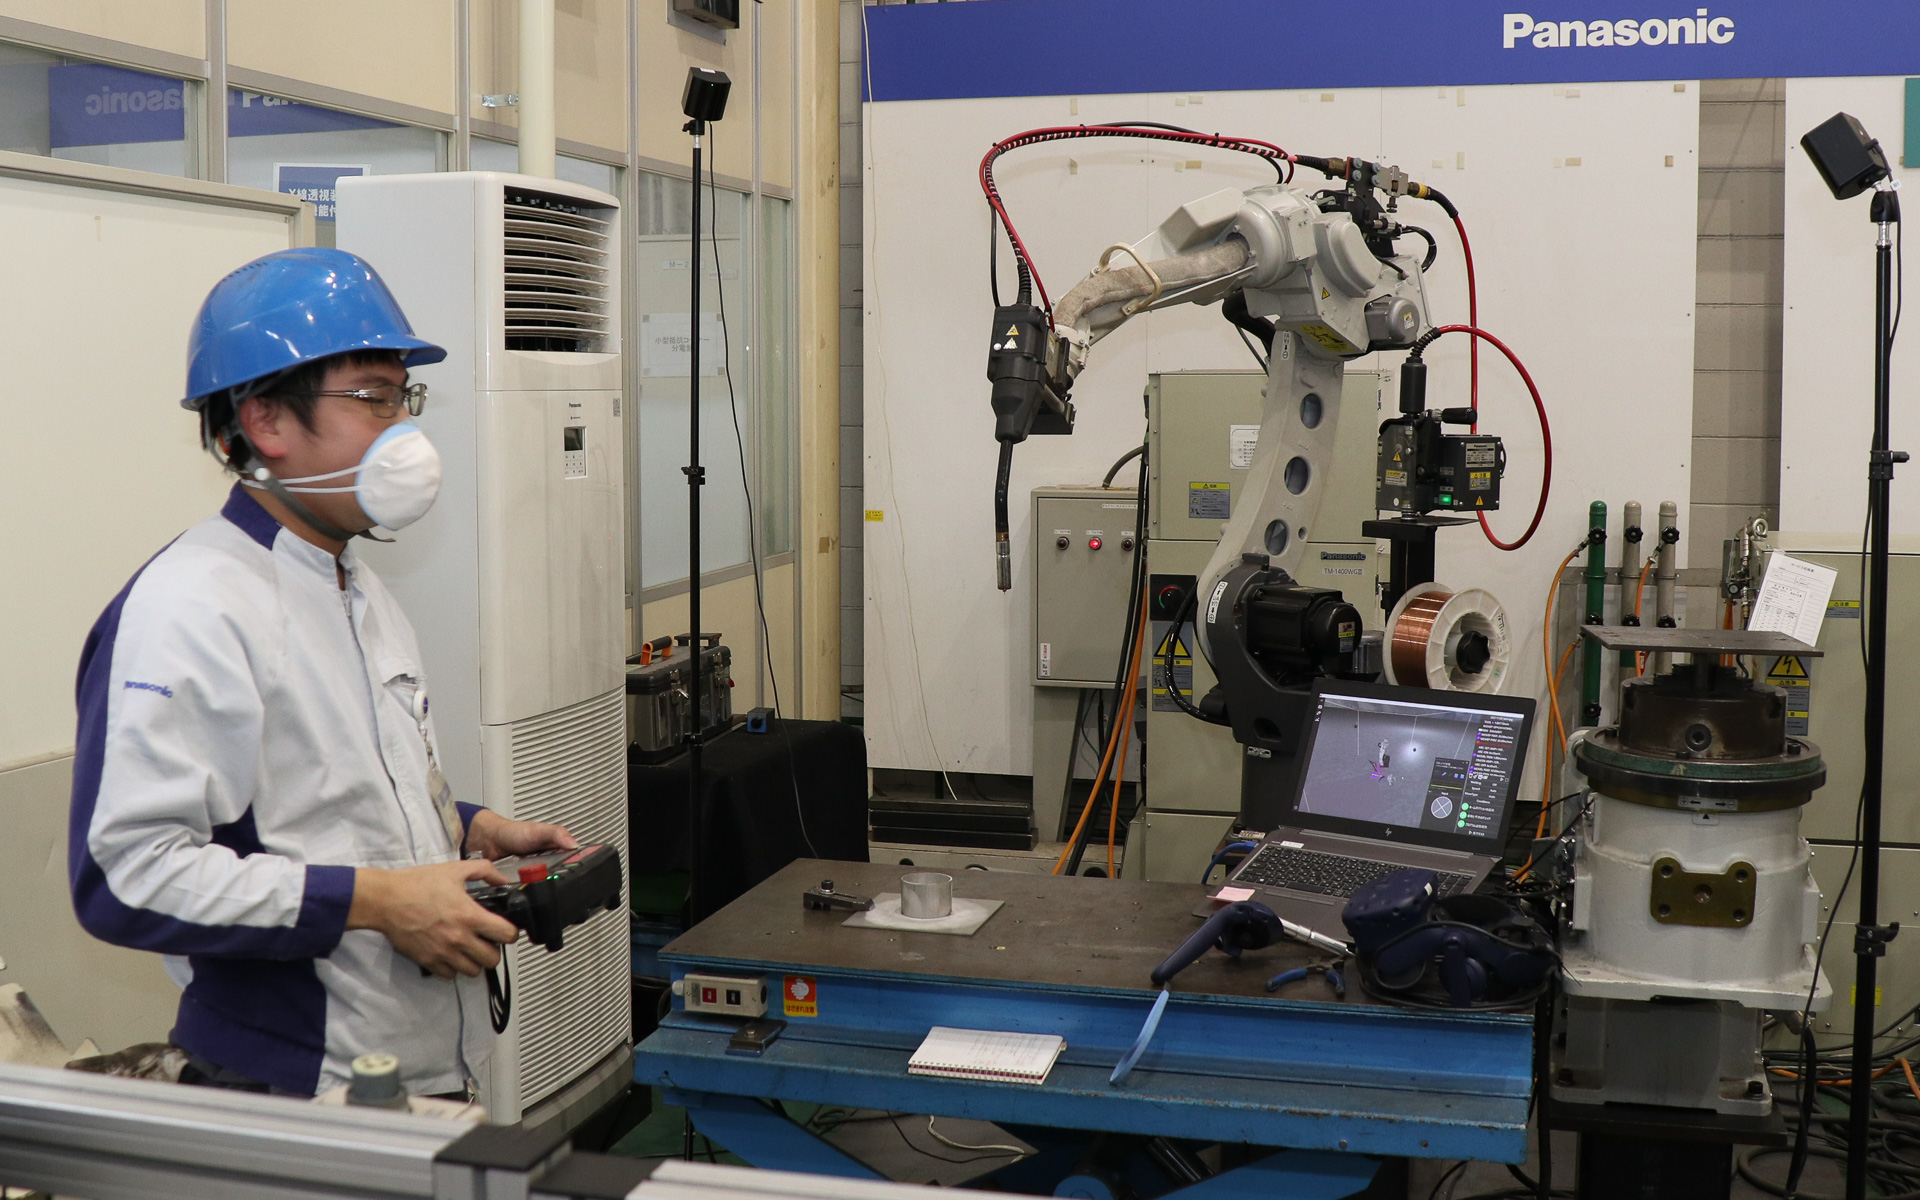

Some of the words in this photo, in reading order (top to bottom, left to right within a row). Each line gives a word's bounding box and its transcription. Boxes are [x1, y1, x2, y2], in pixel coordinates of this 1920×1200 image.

[1502, 8, 1736, 48] Panasonic
[655, 336, 710, 345] 小型抵抗コー
[1321, 551, 1366, 560] Panasonic
